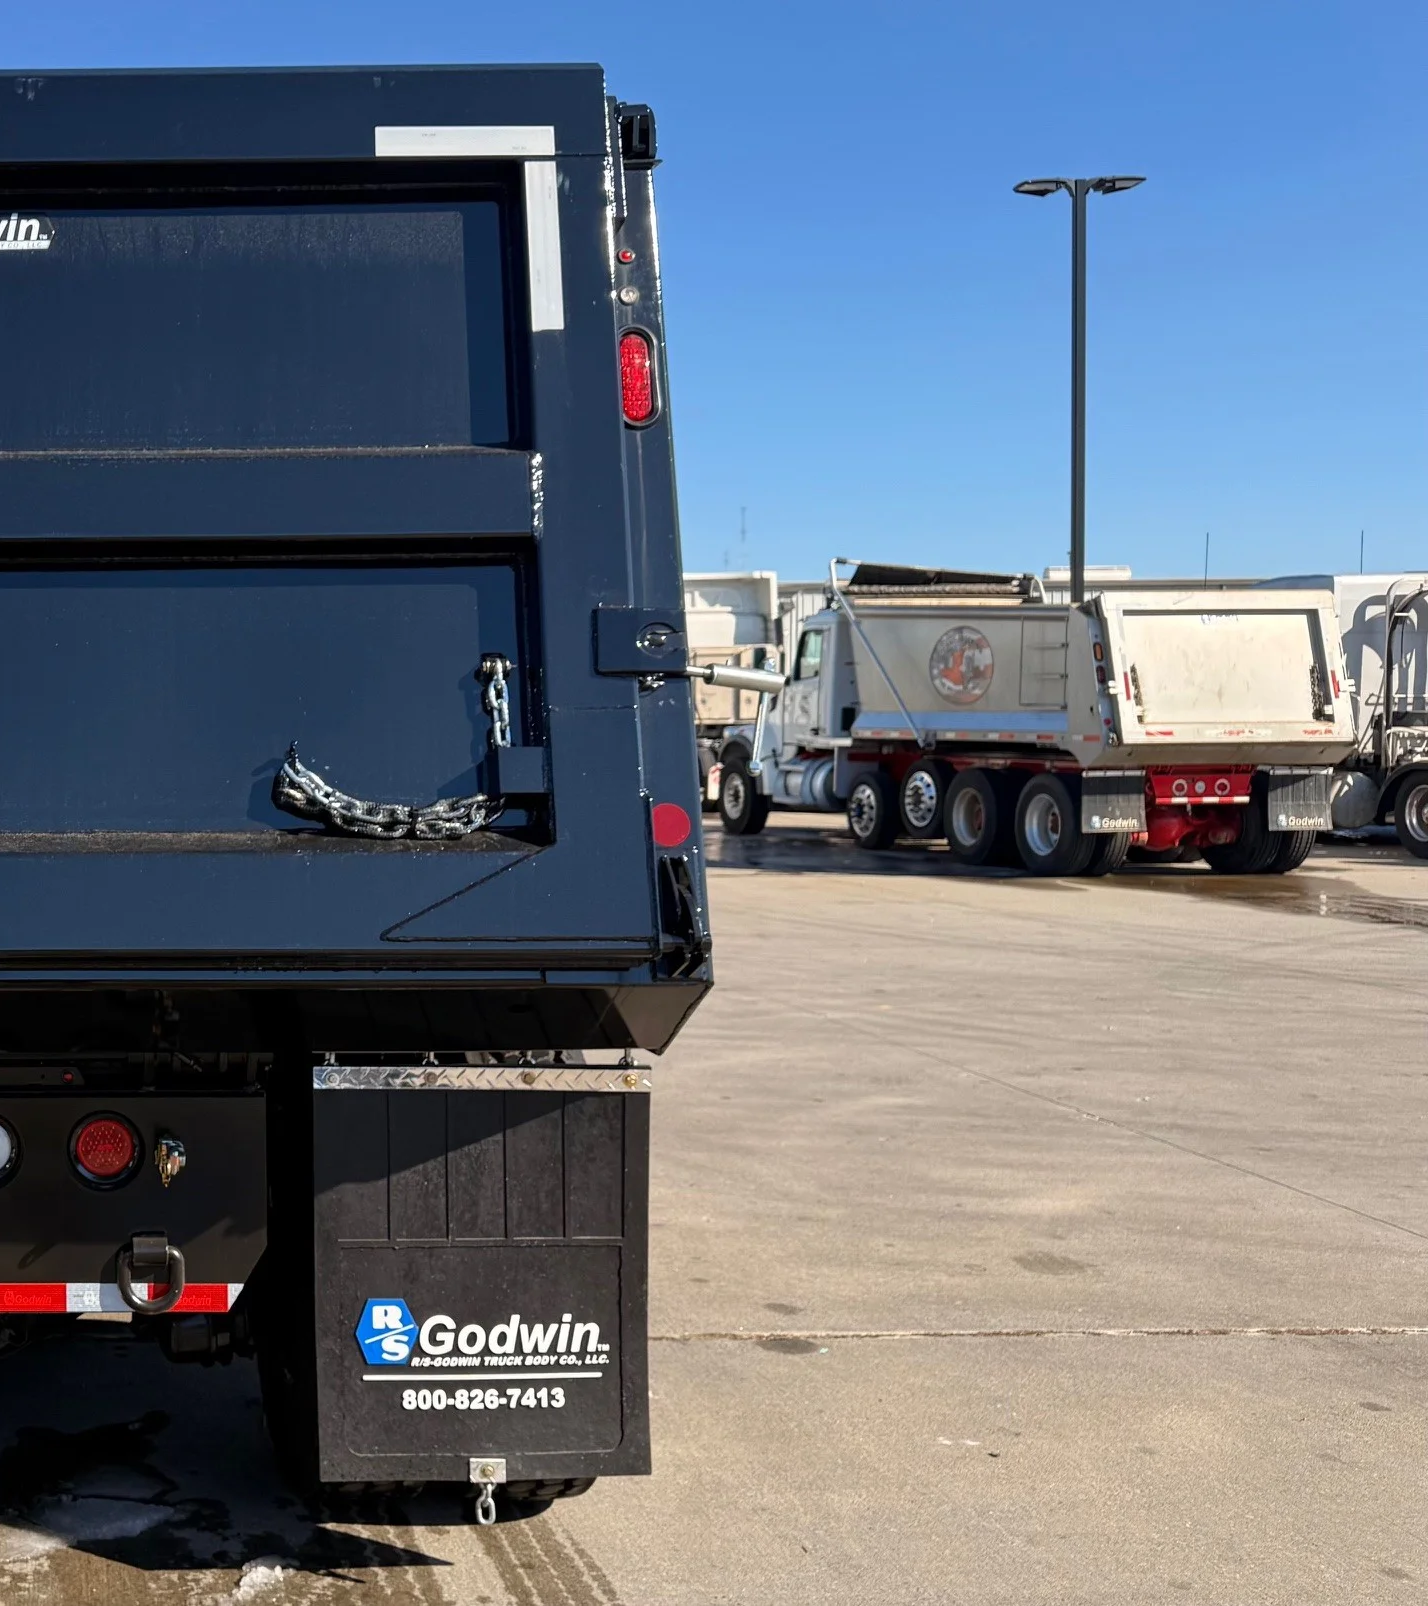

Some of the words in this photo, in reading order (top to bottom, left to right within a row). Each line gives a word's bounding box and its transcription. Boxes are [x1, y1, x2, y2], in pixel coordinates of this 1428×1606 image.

[1102, 817, 1139, 828] Godwin
[1288, 816, 1325, 827] Godwin
[15, 1295, 52, 1305] Godwin
[419, 1313, 600, 1355] Godwin
[410, 1356, 481, 1367] R/S-GODWIN
[483, 1355, 523, 1366] TRUCK
[524, 1355, 558, 1366] BODY
[401, 1387, 566, 1410] 800-826-7413
